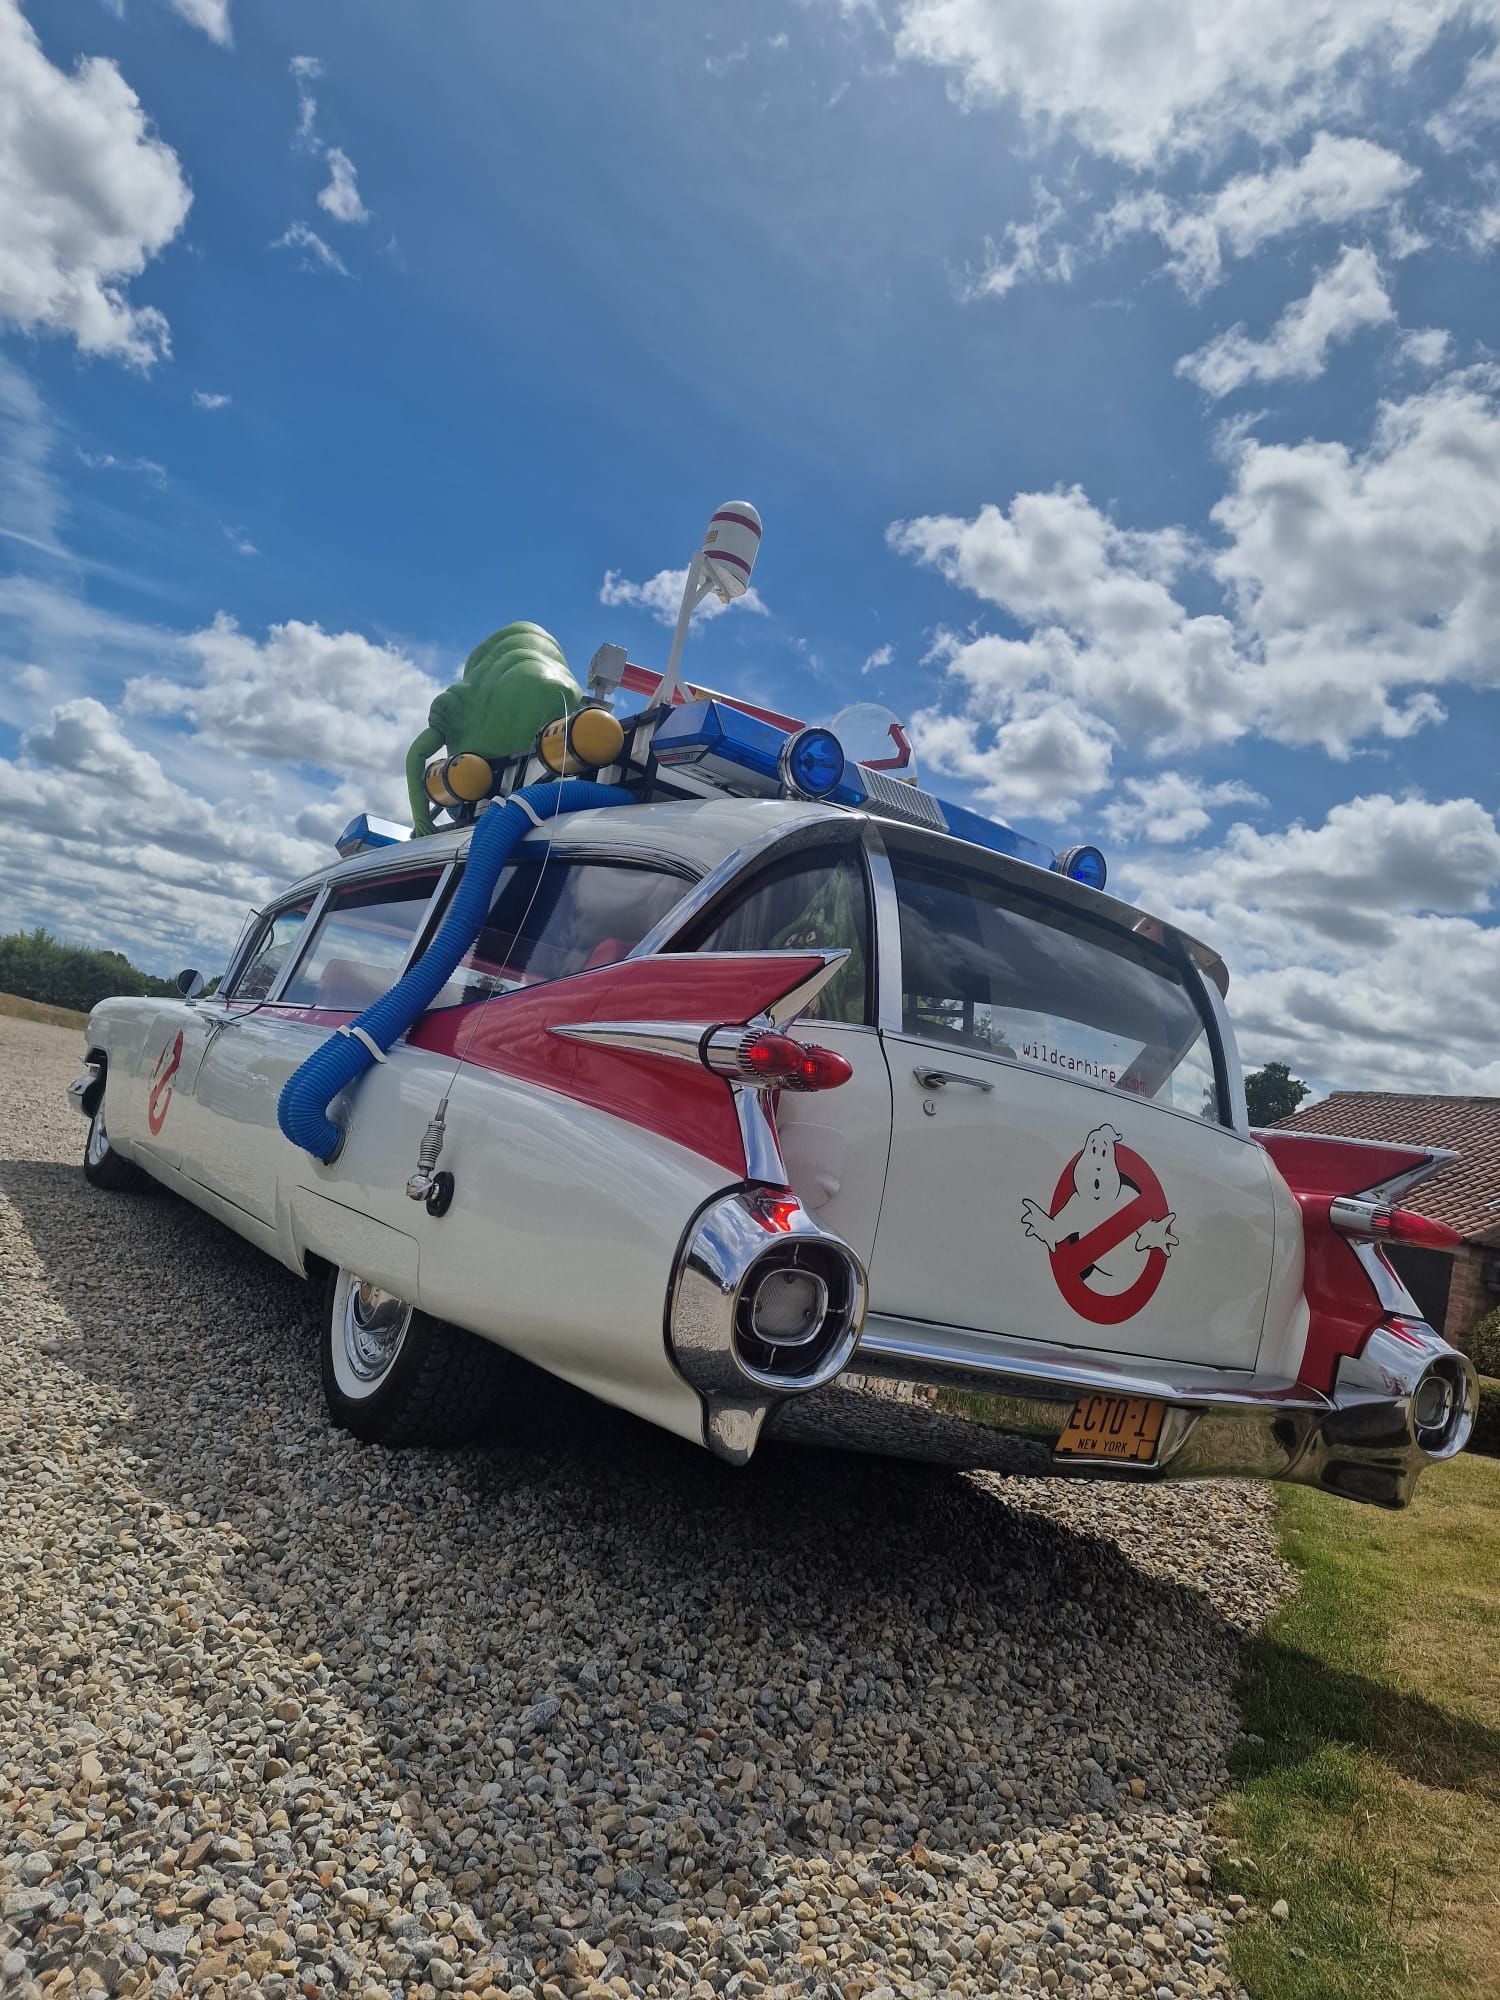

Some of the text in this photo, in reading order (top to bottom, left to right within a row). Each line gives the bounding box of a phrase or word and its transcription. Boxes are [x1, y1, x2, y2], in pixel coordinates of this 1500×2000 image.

[1068, 1396, 1150, 1437] ECTO-1
[1077, 1438, 1128, 1453] NEW YORK
